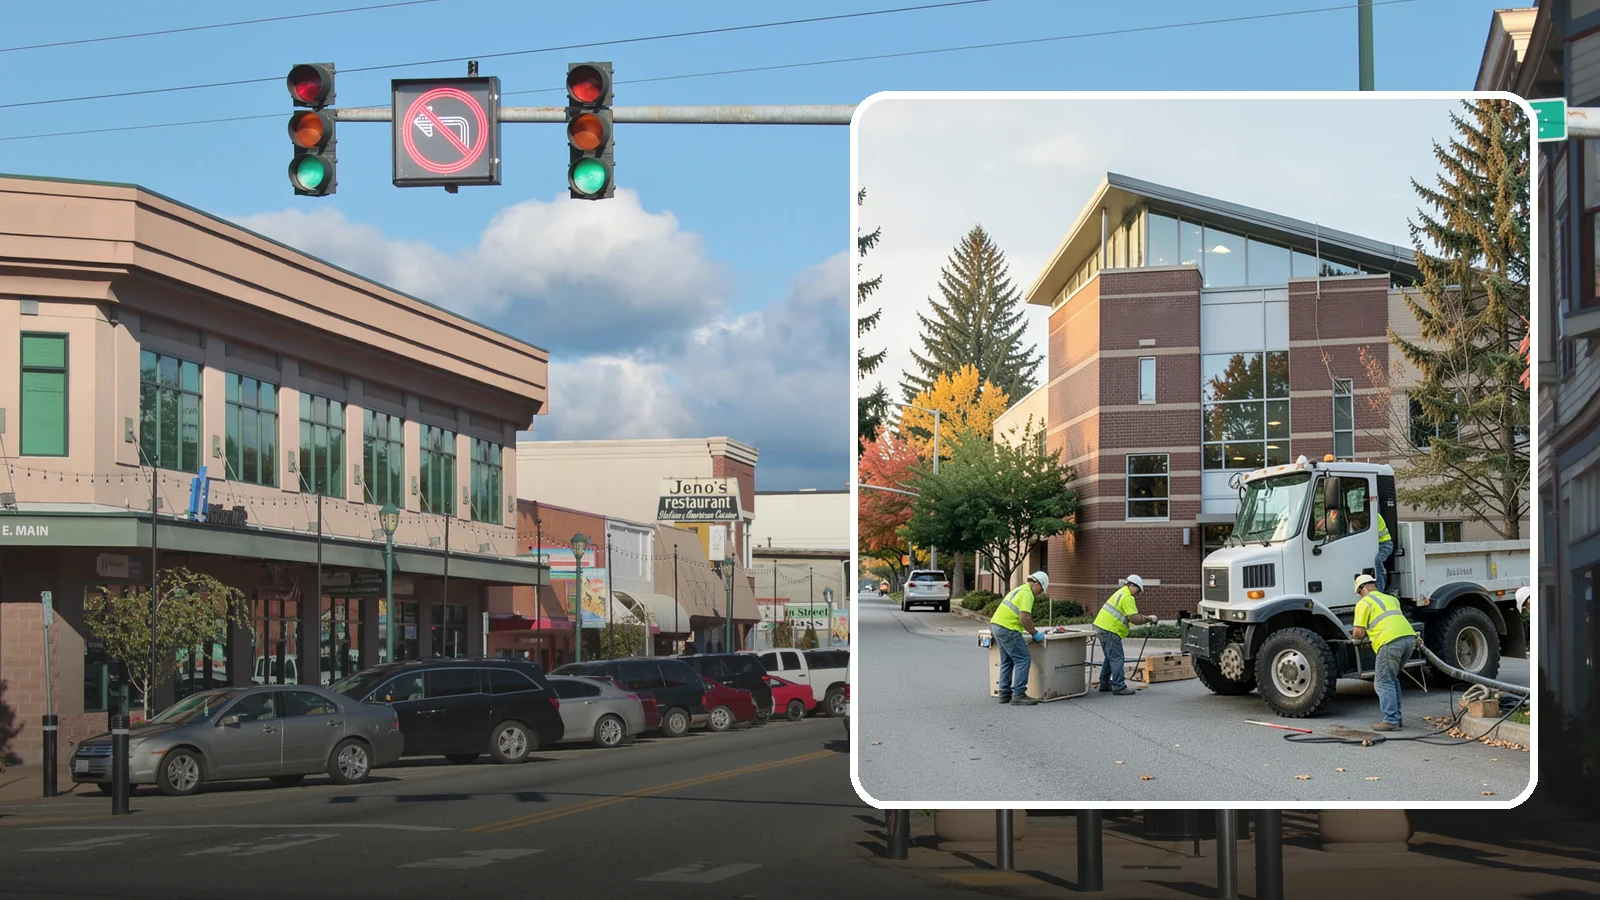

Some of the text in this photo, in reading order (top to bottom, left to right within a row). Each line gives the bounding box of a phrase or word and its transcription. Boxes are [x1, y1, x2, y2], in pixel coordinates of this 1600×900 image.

[669, 480, 727, 494] Jeno's
[665, 496, 731, 509] restaurant
[658, 510, 682, 520] Italian
[686, 510, 714, 519] American
[715, 509, 737, 519] Cuisine
[2, 525, 49, 536] E. MAIN
[797, 607, 828, 617] Street
